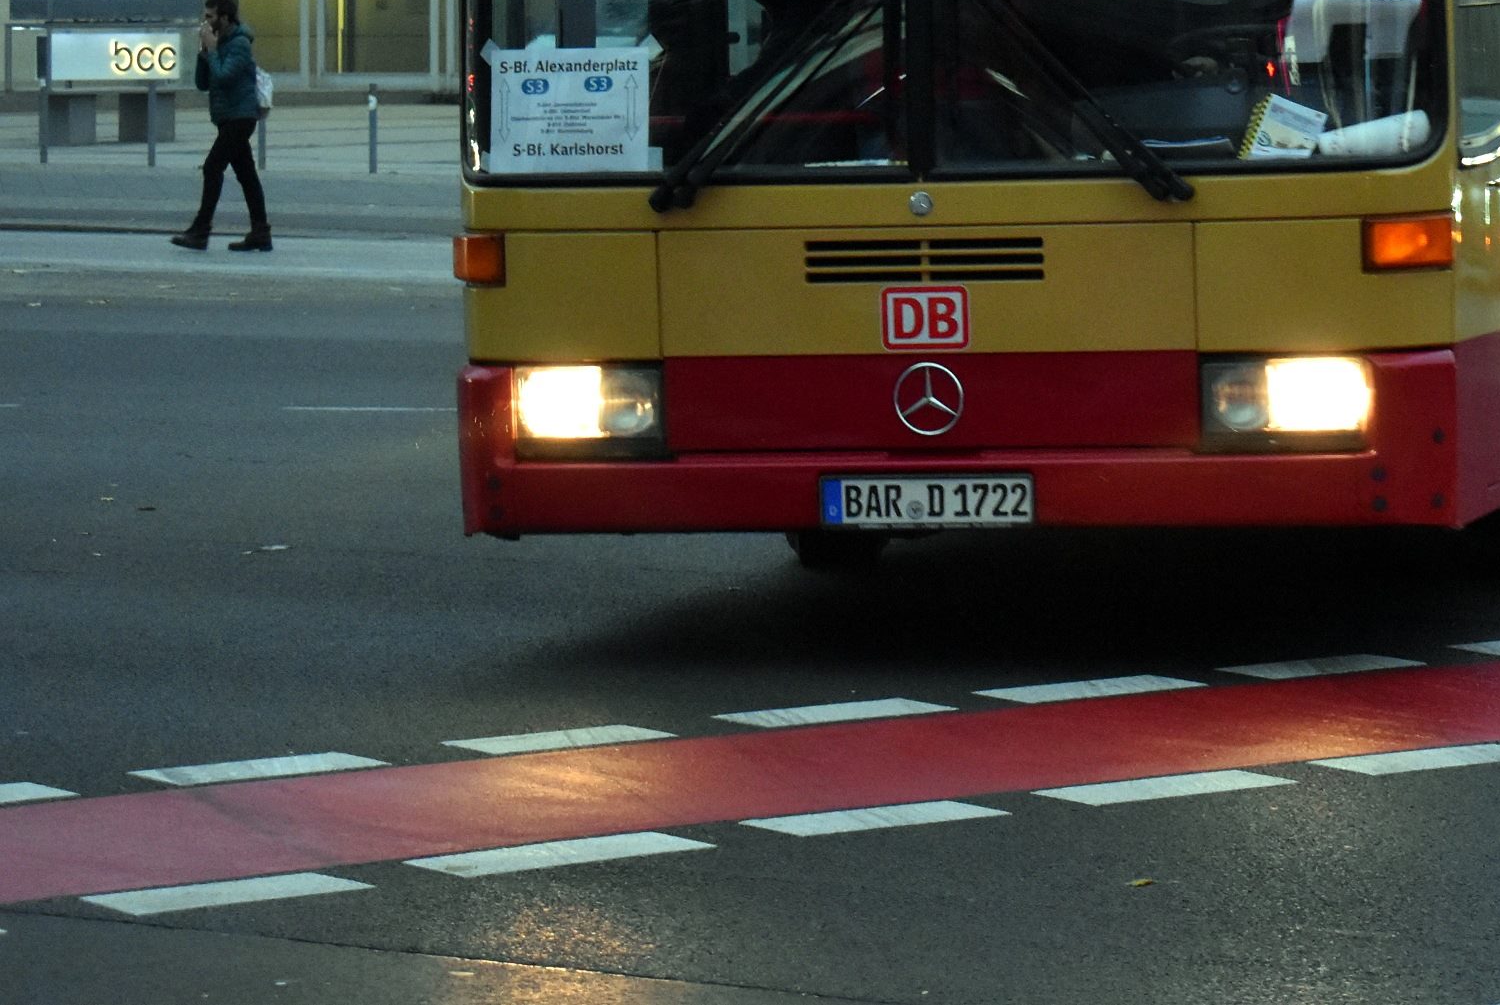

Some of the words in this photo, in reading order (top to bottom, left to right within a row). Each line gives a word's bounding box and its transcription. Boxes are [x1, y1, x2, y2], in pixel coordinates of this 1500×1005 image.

[500, 61, 530, 74] S-Bf.
[535, 59, 638, 74] Alexanderplatz
[526, 79, 545, 94] S3
[588, 77, 608, 91] S3
[513, 144, 546, 157] S-Bf.
[551, 142, 624, 156] Karlshorst
[892, 297, 959, 340] DB
[844, 484, 902, 518] BAR
[927, 484, 945, 517] D
[953, 483, 1028, 517] 1722
